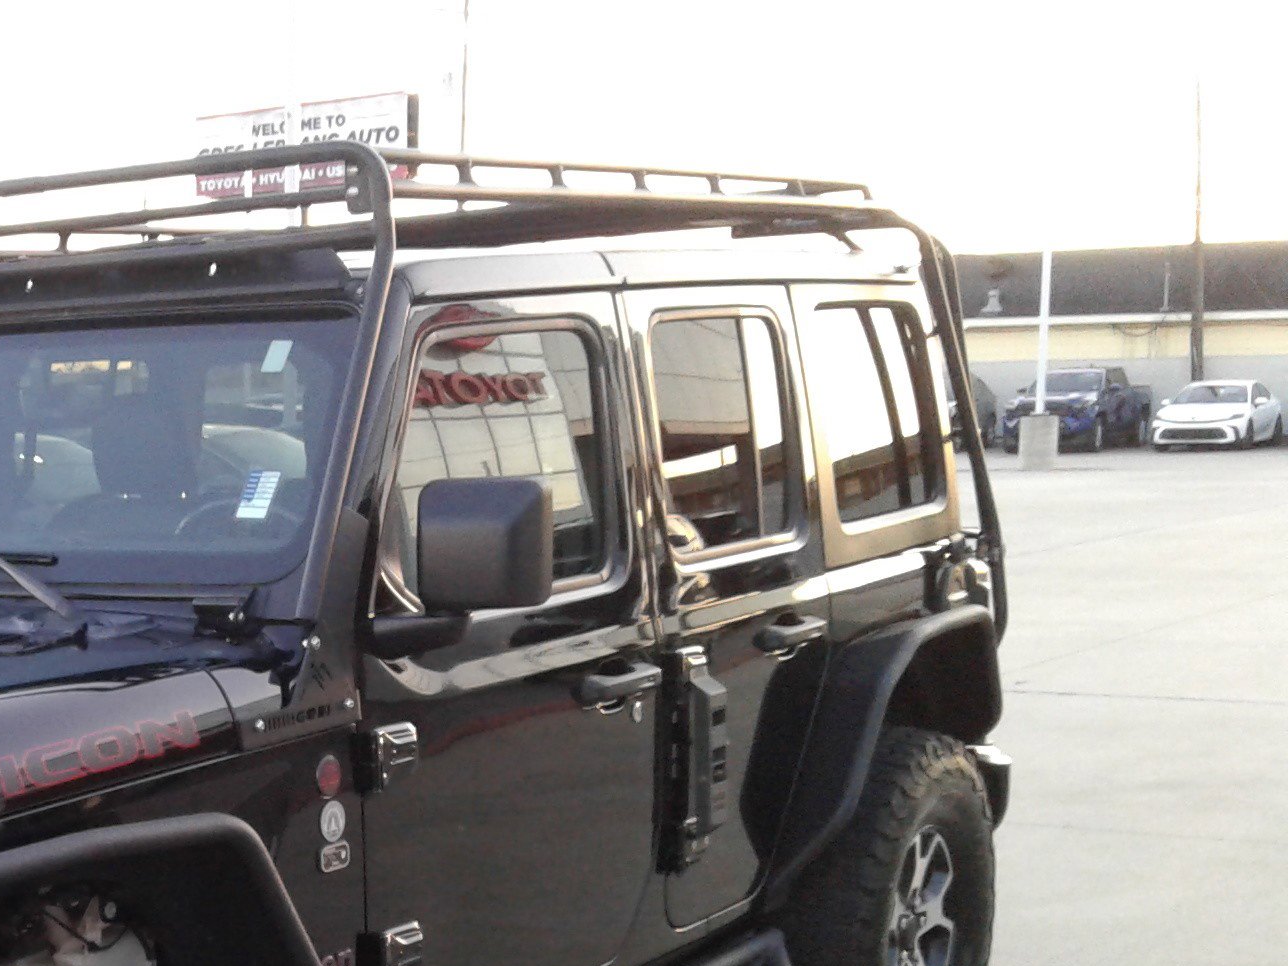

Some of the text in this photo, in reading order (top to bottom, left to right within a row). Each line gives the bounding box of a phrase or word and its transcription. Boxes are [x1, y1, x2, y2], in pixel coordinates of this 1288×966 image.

[252, 114, 346, 137] WELCME TO
[347, 125, 400, 145] AUTO
